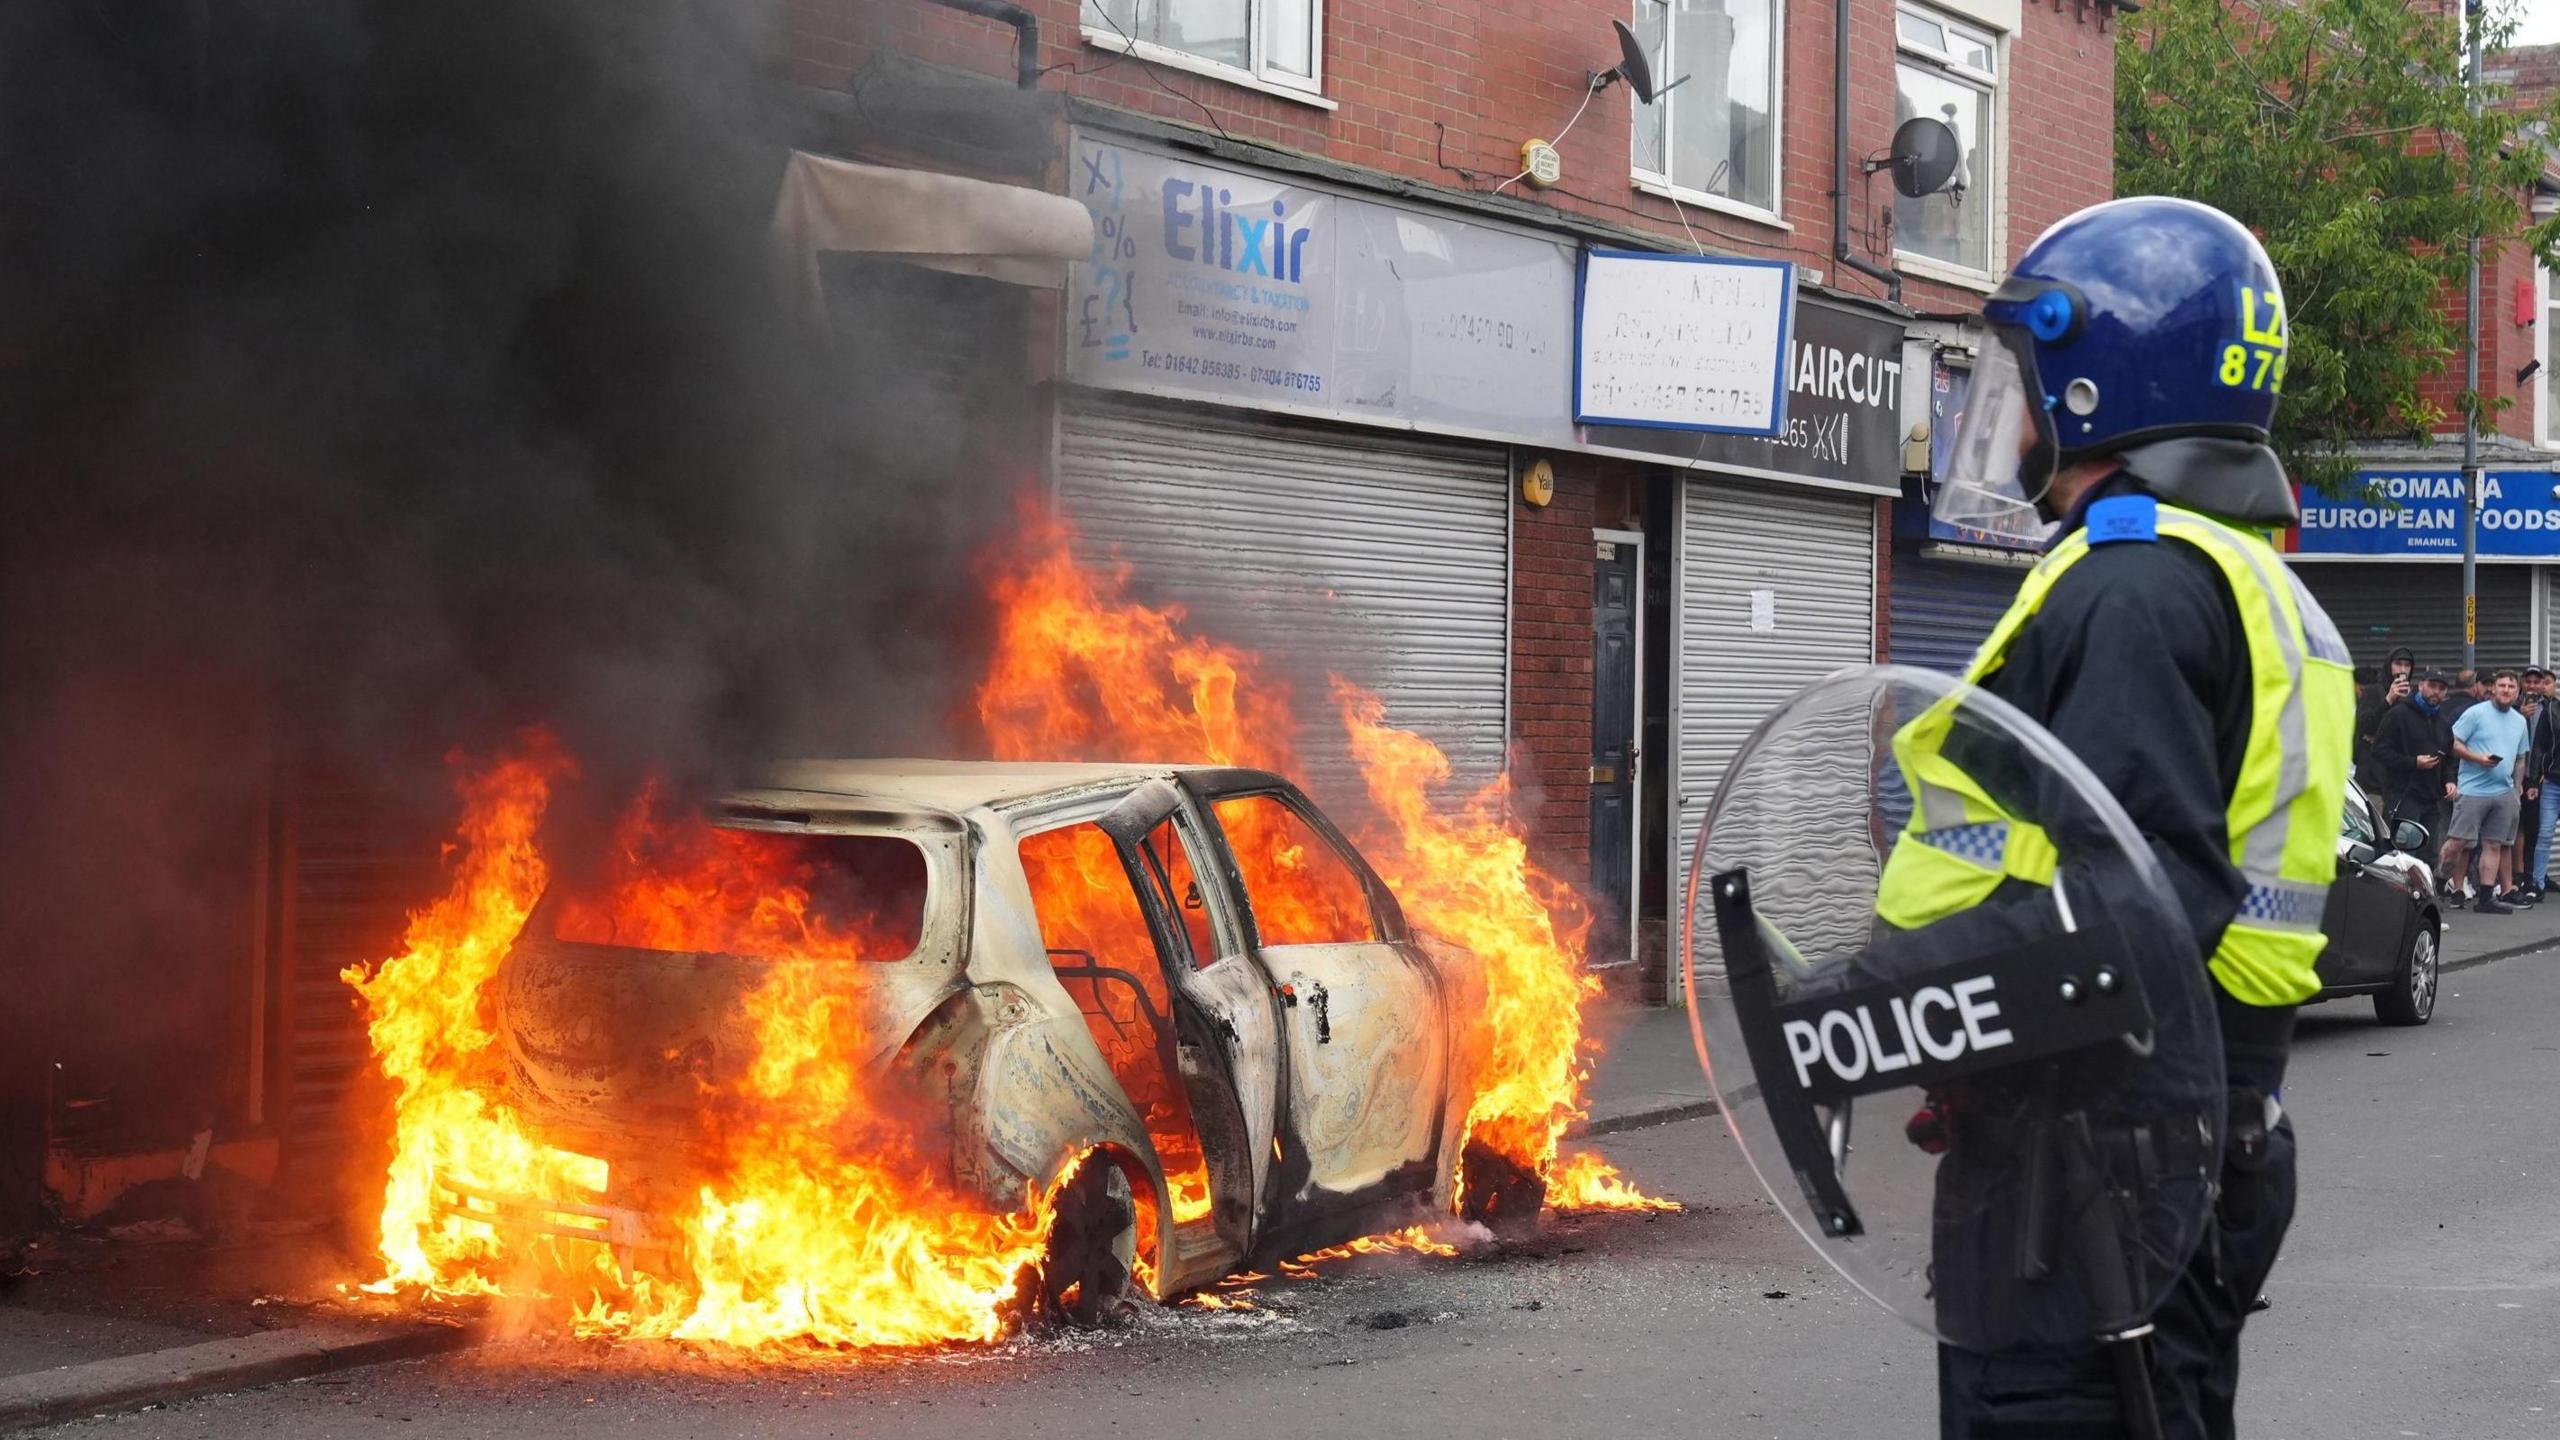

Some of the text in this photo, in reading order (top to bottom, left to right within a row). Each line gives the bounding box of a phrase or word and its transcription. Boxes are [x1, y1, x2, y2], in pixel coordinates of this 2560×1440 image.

[1162, 178, 1311, 283] Elixir
[1178, 300, 1297, 333] Email: info@elixirbs.com
[2241, 287, 2284, 349] LZ
[1192, 325, 1276, 350] www.elixirbs.com
[1142, 350, 1160, 368] Tel:
[1165, 353, 1198, 375] 01642
[1201, 359, 1241, 380] 956385
[1251, 367, 1281, 386] 07404
[2301, 508, 2455, 530] EUROPEAN
[2408, 537, 2457, 547] EMANUEL
[1783, 975, 2014, 1088] POLICE
